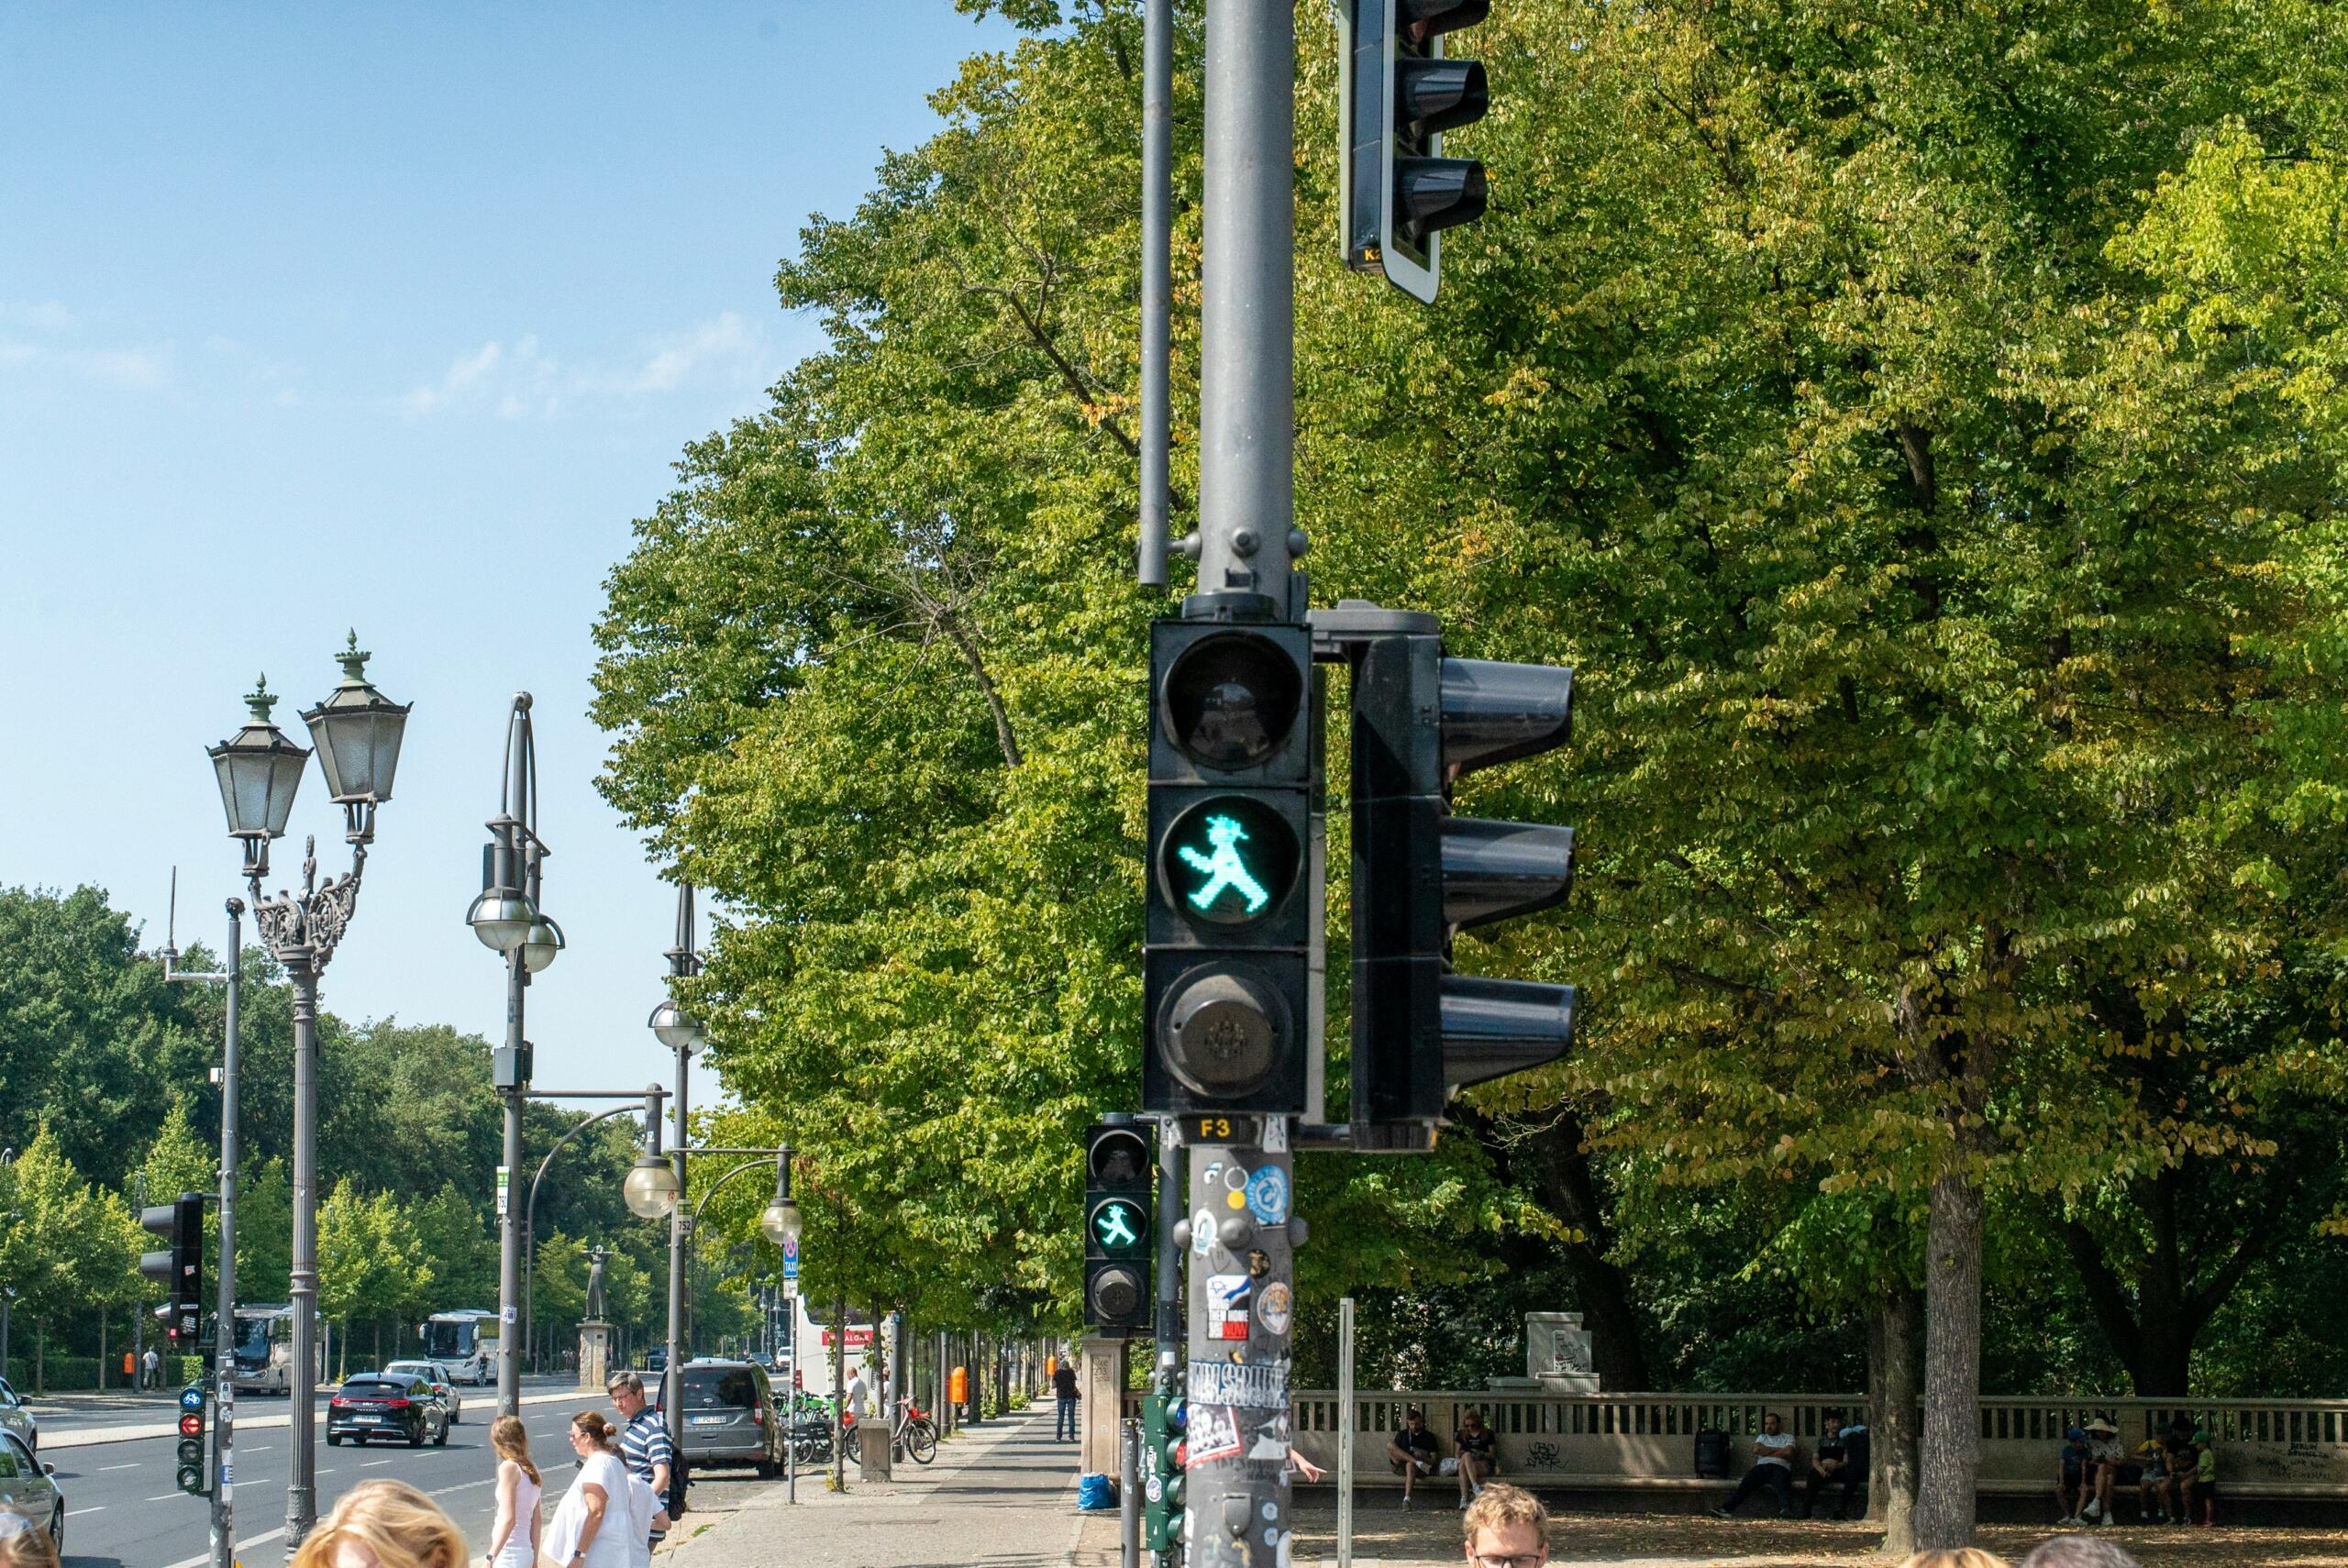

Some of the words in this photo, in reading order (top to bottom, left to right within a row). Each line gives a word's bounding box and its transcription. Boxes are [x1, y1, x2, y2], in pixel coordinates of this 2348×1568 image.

[1201, 1119, 1231, 1137] F3
[679, 1220, 691, 1231] 752
[785, 1261, 797, 1272] TAXI
[1224, 1321, 1247, 1337] NOW
